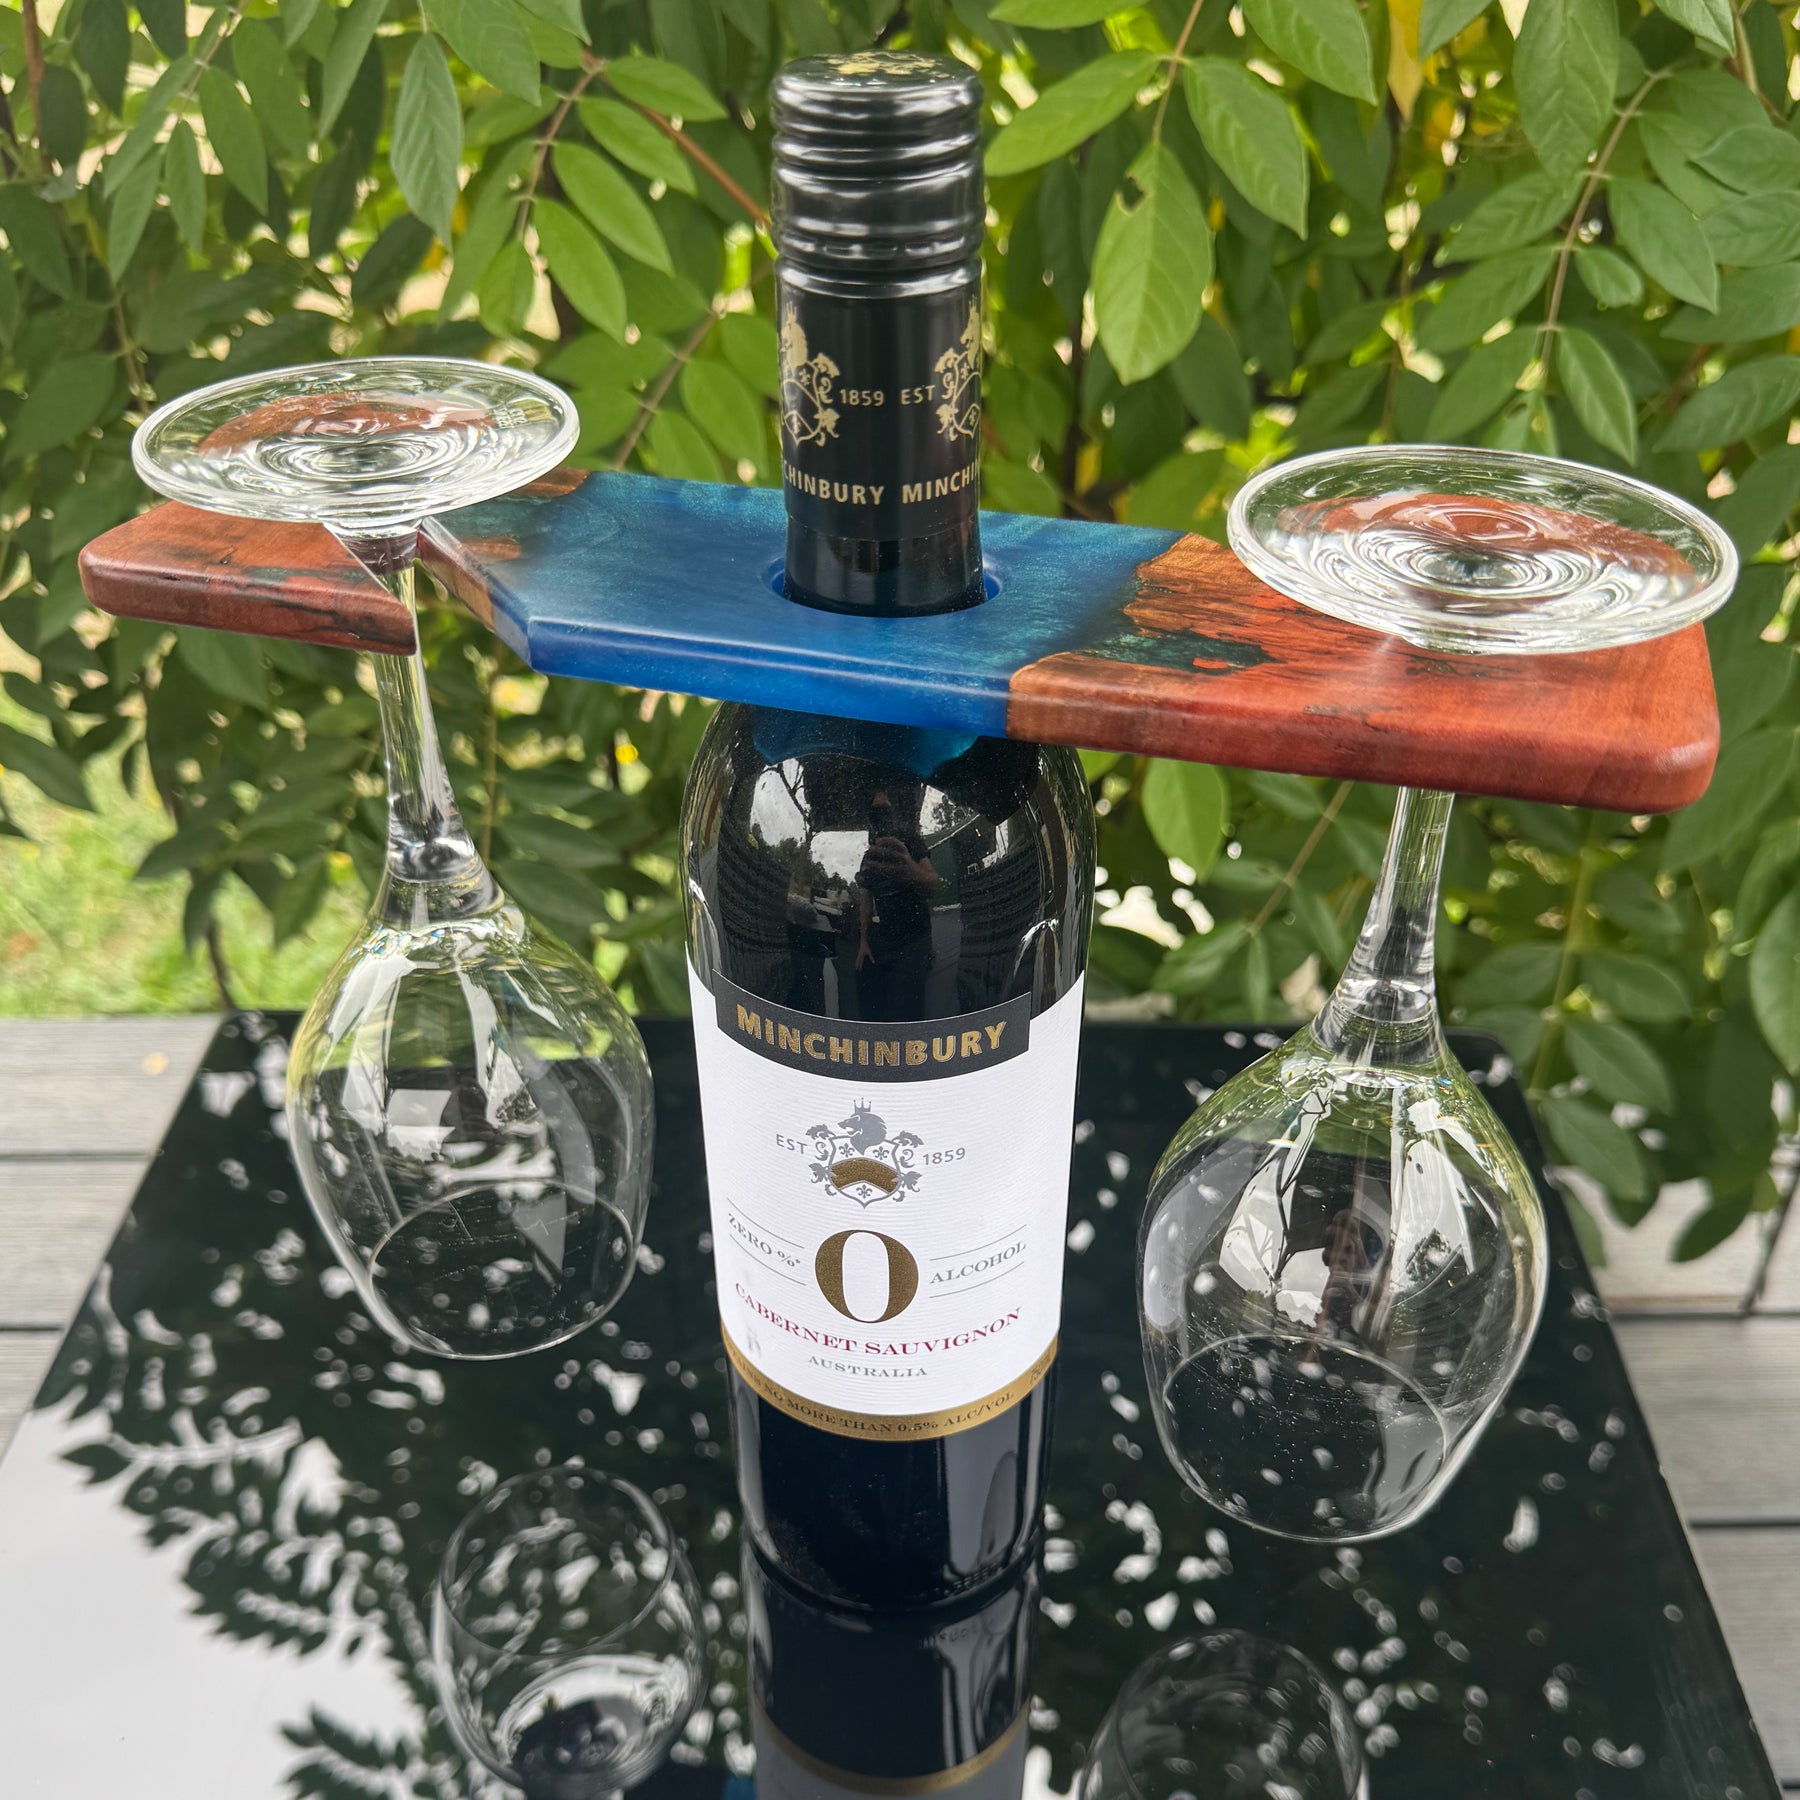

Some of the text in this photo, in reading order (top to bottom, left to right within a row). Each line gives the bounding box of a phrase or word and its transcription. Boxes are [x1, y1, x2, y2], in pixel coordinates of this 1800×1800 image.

[839, 384, 936, 407] 1859 EST
[736, 1004, 1007, 1066] MINCHINBURY
[776, 1133, 966, 1166] EST 1859
[728, 1213, 772, 1255] ZERO
[929, 1240, 1027, 1284] ALCOHOL
[735, 1282, 1022, 1356] CABERNET SAUVIGNON
[809, 1355, 928, 1378] AUSTRALIA
[787, 1398, 836, 1424] MORE
[839, 1418, 891, 1432] THAN
[897, 1421, 939, 1433] 0.5%
[944, 1392, 1015, 1427] ALC/VOL
